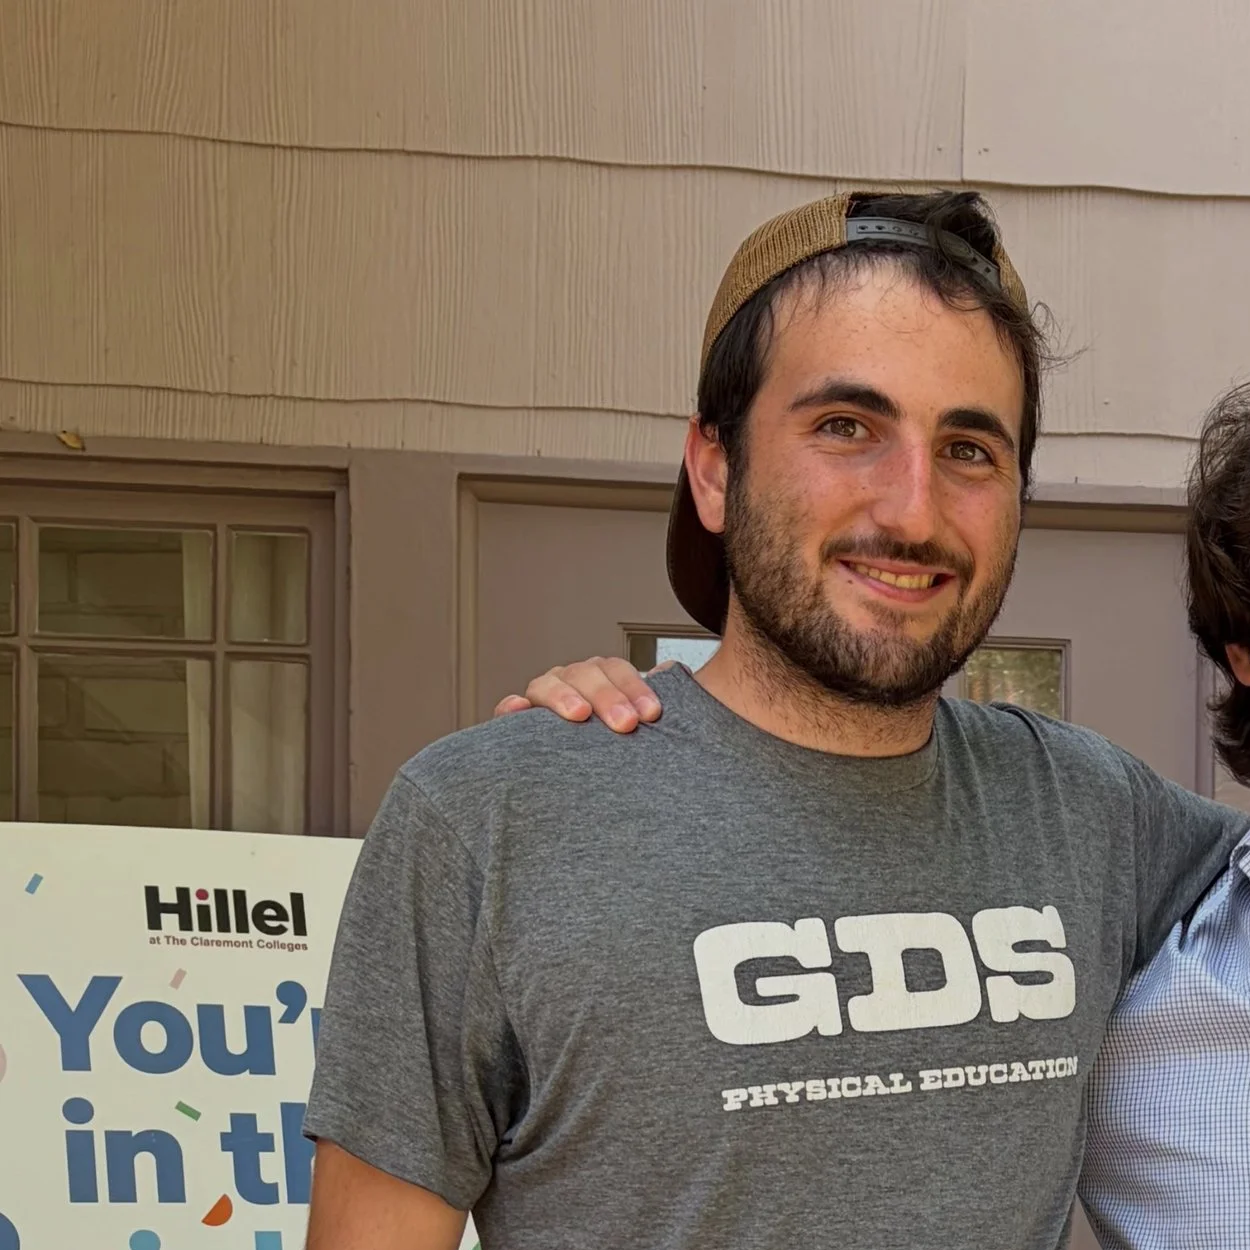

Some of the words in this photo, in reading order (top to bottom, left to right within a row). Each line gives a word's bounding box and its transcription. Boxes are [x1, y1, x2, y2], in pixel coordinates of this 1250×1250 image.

[144, 885, 308, 936] Hillel
[149, 936, 162, 945] at
[164, 936, 187, 946] The
[190, 937, 253, 949] Claremont
[257, 939, 308, 952] Colleges
[693, 904, 1076, 1045] GDS
[17, 974, 322, 1076] You'
[721, 1072, 913, 1112] PHYSICAL
[918, 1056, 1078, 1091] EDUCATION
[62, 1097, 187, 1204] in
